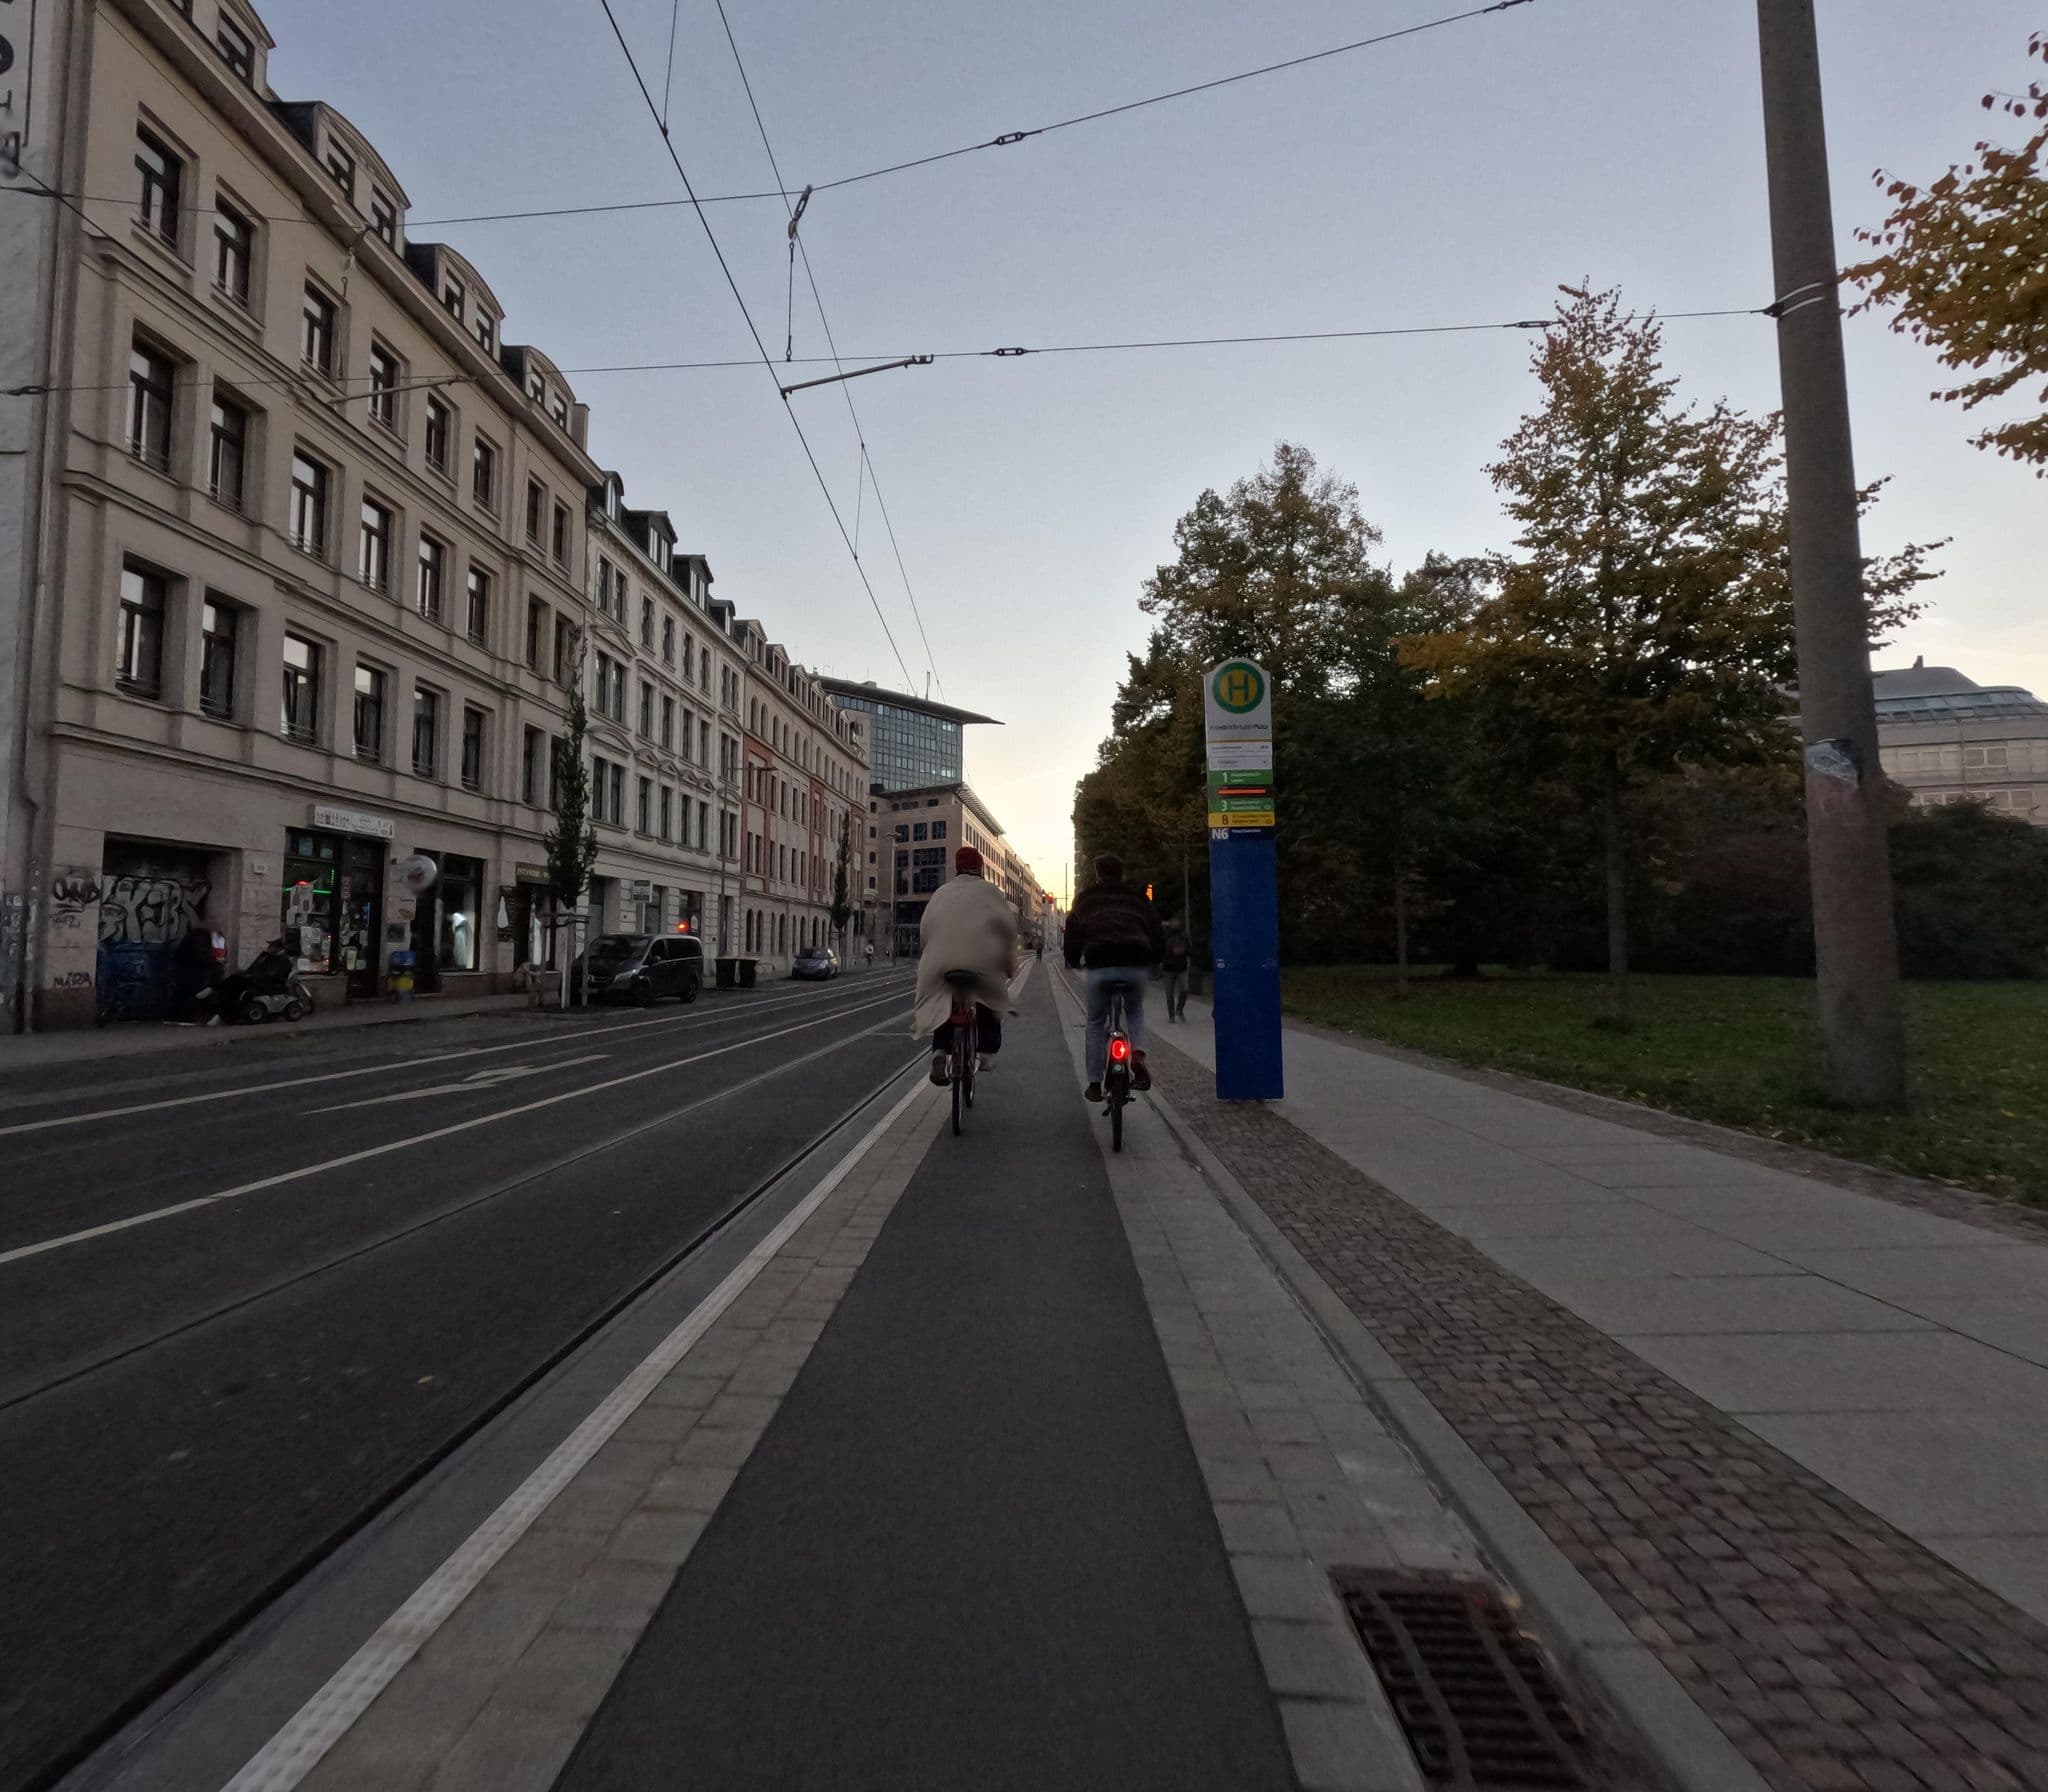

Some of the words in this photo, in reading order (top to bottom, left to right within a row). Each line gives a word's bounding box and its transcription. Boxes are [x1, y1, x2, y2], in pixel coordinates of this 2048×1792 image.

[1228, 674, 1249, 701] H
[1222, 772, 1228, 783] 1
[1221, 800, 1228, 811] 3
[1221, 814, 1229, 825] 8
[1212, 828, 1229, 840] N6
